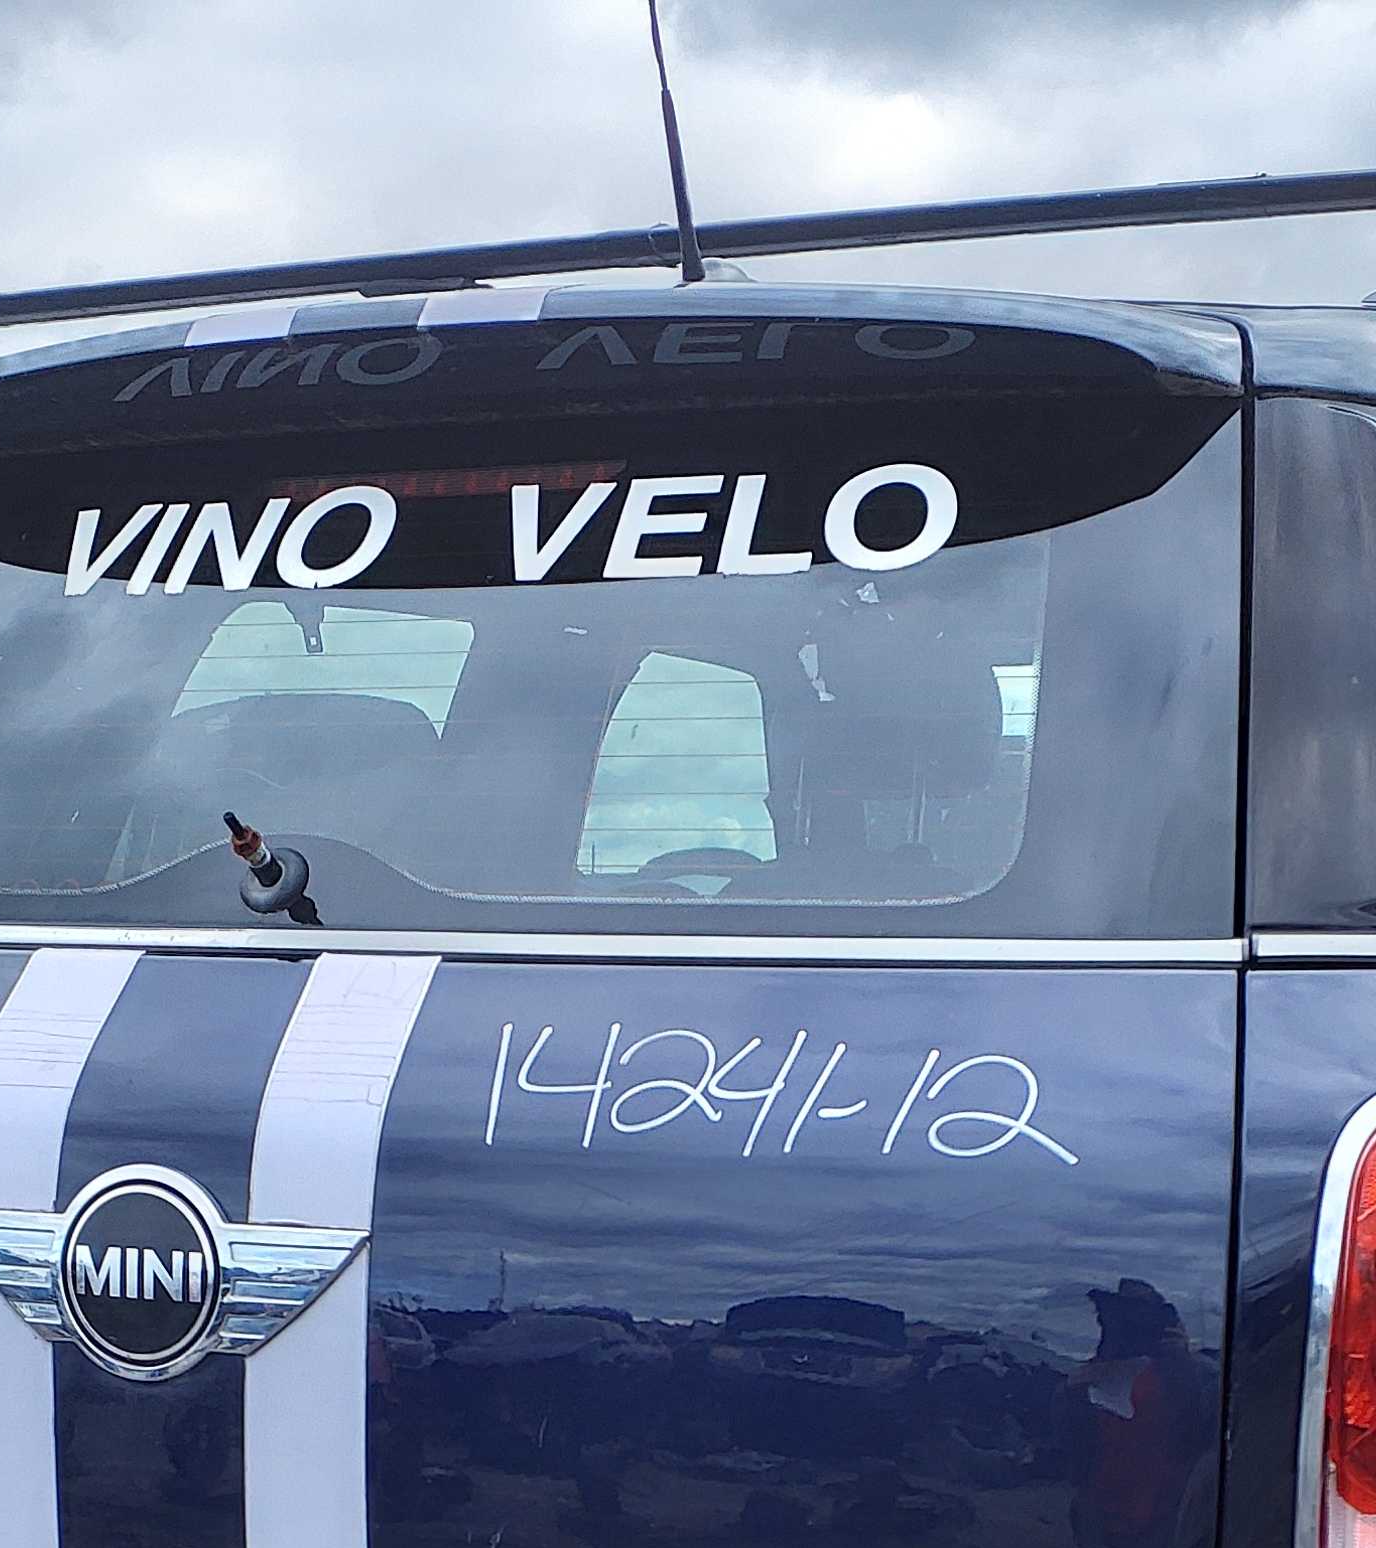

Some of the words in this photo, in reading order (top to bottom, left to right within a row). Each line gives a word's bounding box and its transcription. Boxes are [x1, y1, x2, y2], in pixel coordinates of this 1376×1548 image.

[62, 484, 398, 597] VINO
[509, 462, 959, 582] VELO
[483, 1021, 1080, 1166] 14241-12
[74, 1243, 205, 1304] MINI
